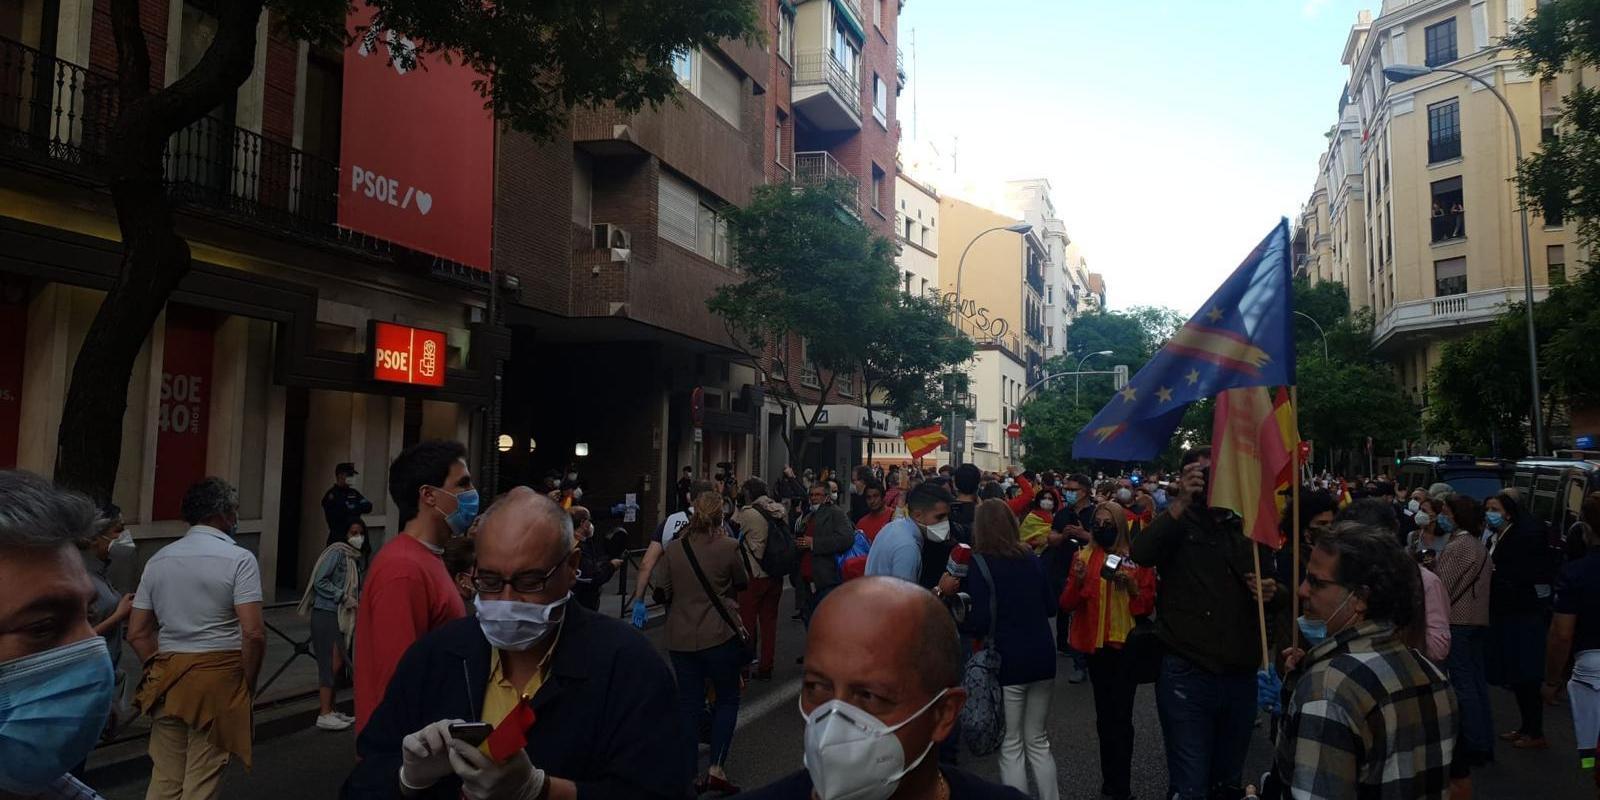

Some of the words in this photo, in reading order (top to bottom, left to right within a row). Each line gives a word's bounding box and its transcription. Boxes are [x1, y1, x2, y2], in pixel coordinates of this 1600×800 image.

[352, 165, 399, 207] PSOE
[375, 348, 408, 371] PSOE
[161, 373, 203, 403] SOE
